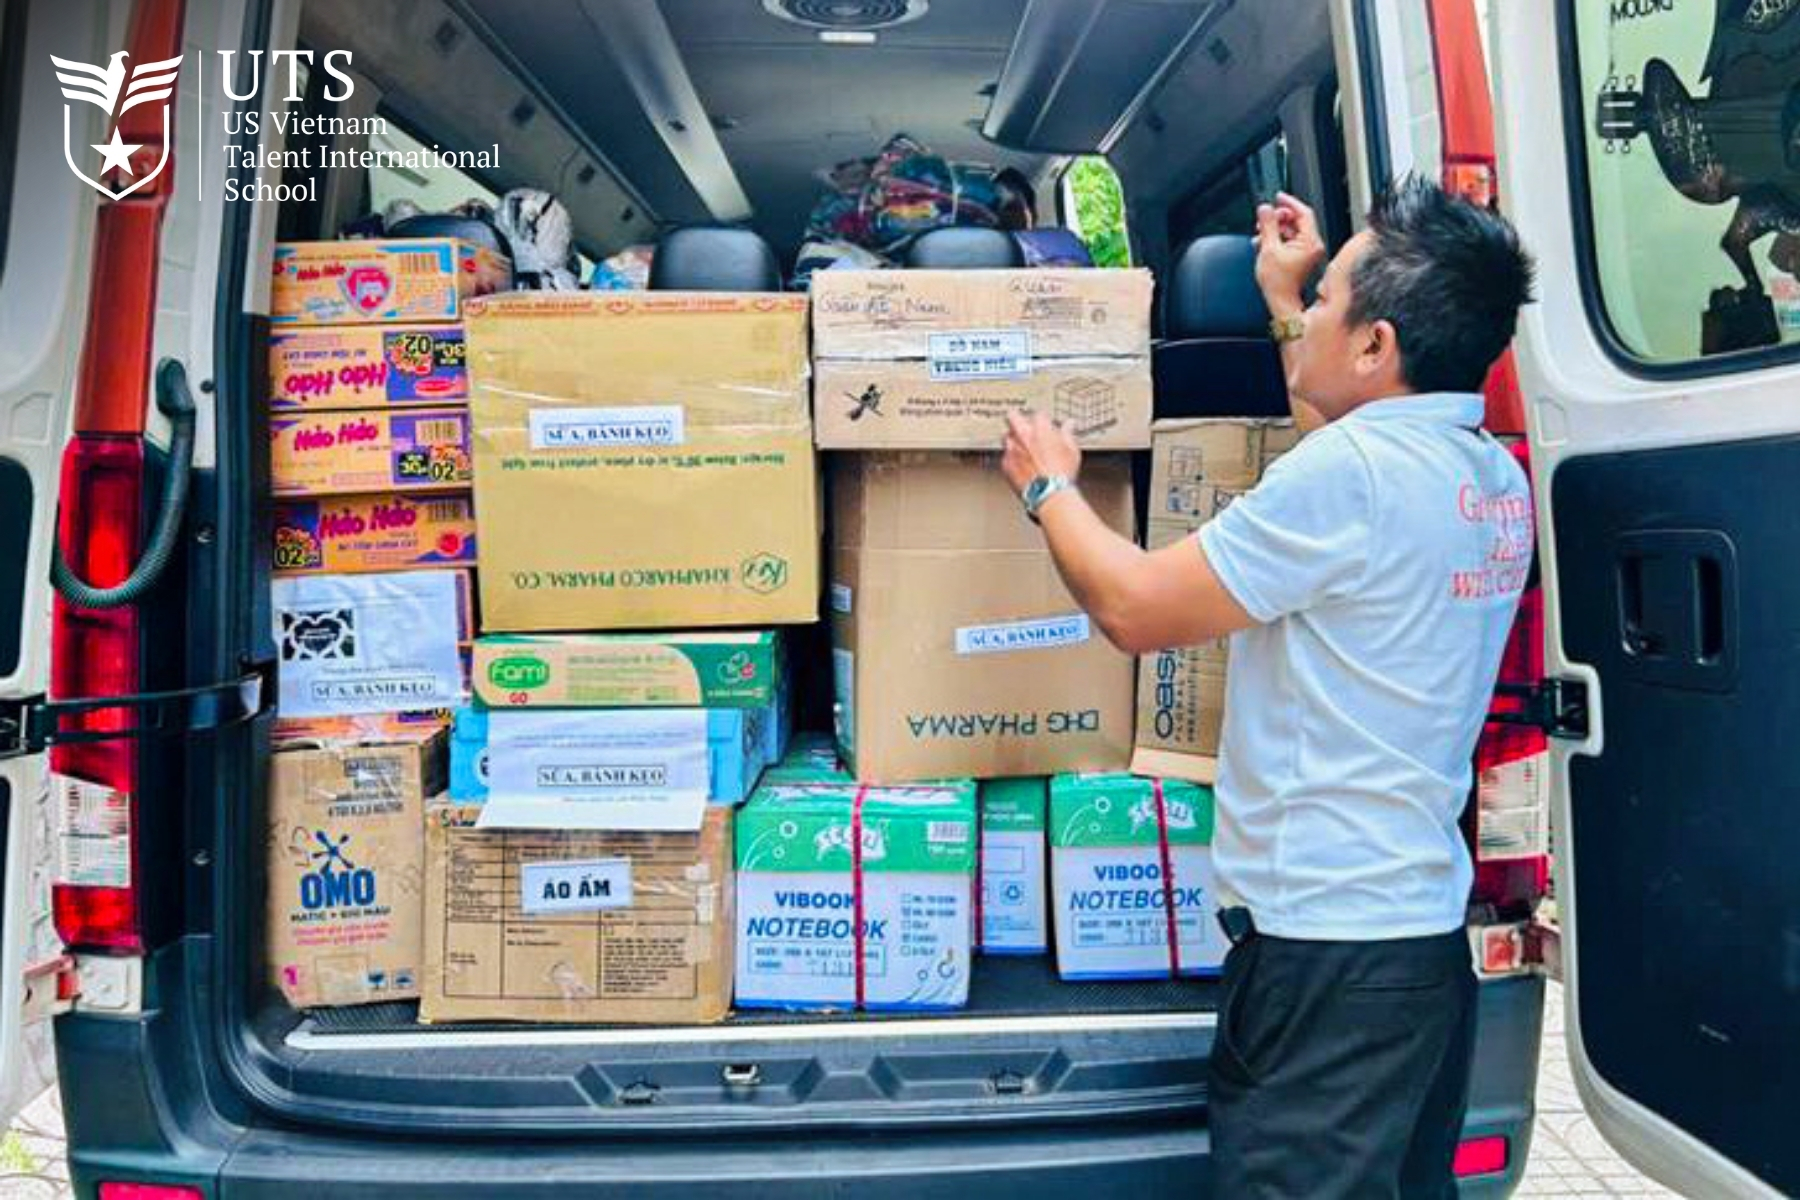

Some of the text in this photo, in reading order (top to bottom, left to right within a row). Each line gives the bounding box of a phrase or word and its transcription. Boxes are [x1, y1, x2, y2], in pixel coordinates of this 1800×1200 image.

[620, 569, 731, 587] KHAPHARCO
[907, 709, 1099, 737] DHG PHARMA
[1094, 864, 1173, 881] VIBOO
[300, 868, 375, 909] OMO
